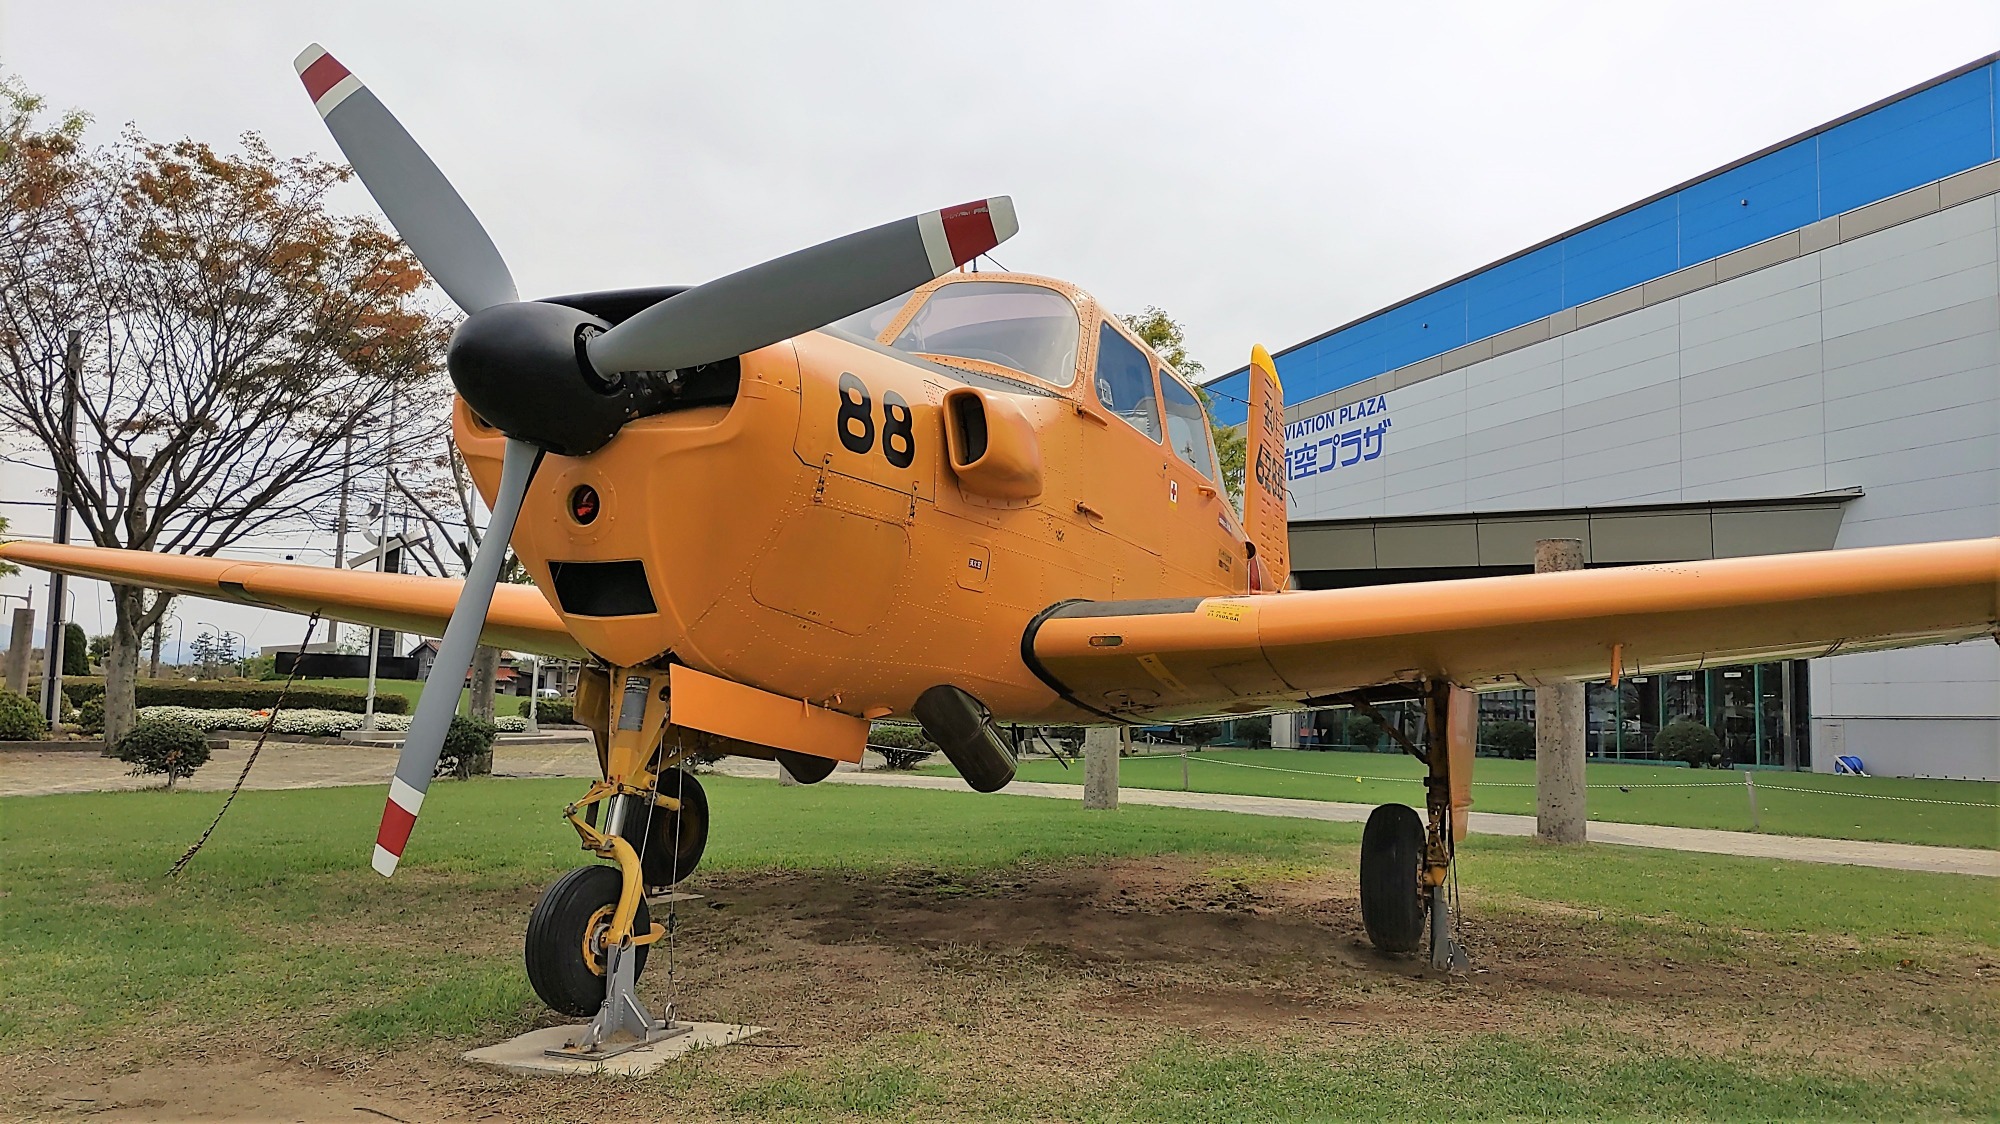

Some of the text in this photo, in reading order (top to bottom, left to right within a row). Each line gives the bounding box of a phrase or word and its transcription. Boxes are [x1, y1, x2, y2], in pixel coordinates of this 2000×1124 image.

[838, 371, 915, 468] 88
[1284, 411, 1335, 441] VIATION
[1339, 395, 1387, 424] PLAZA
